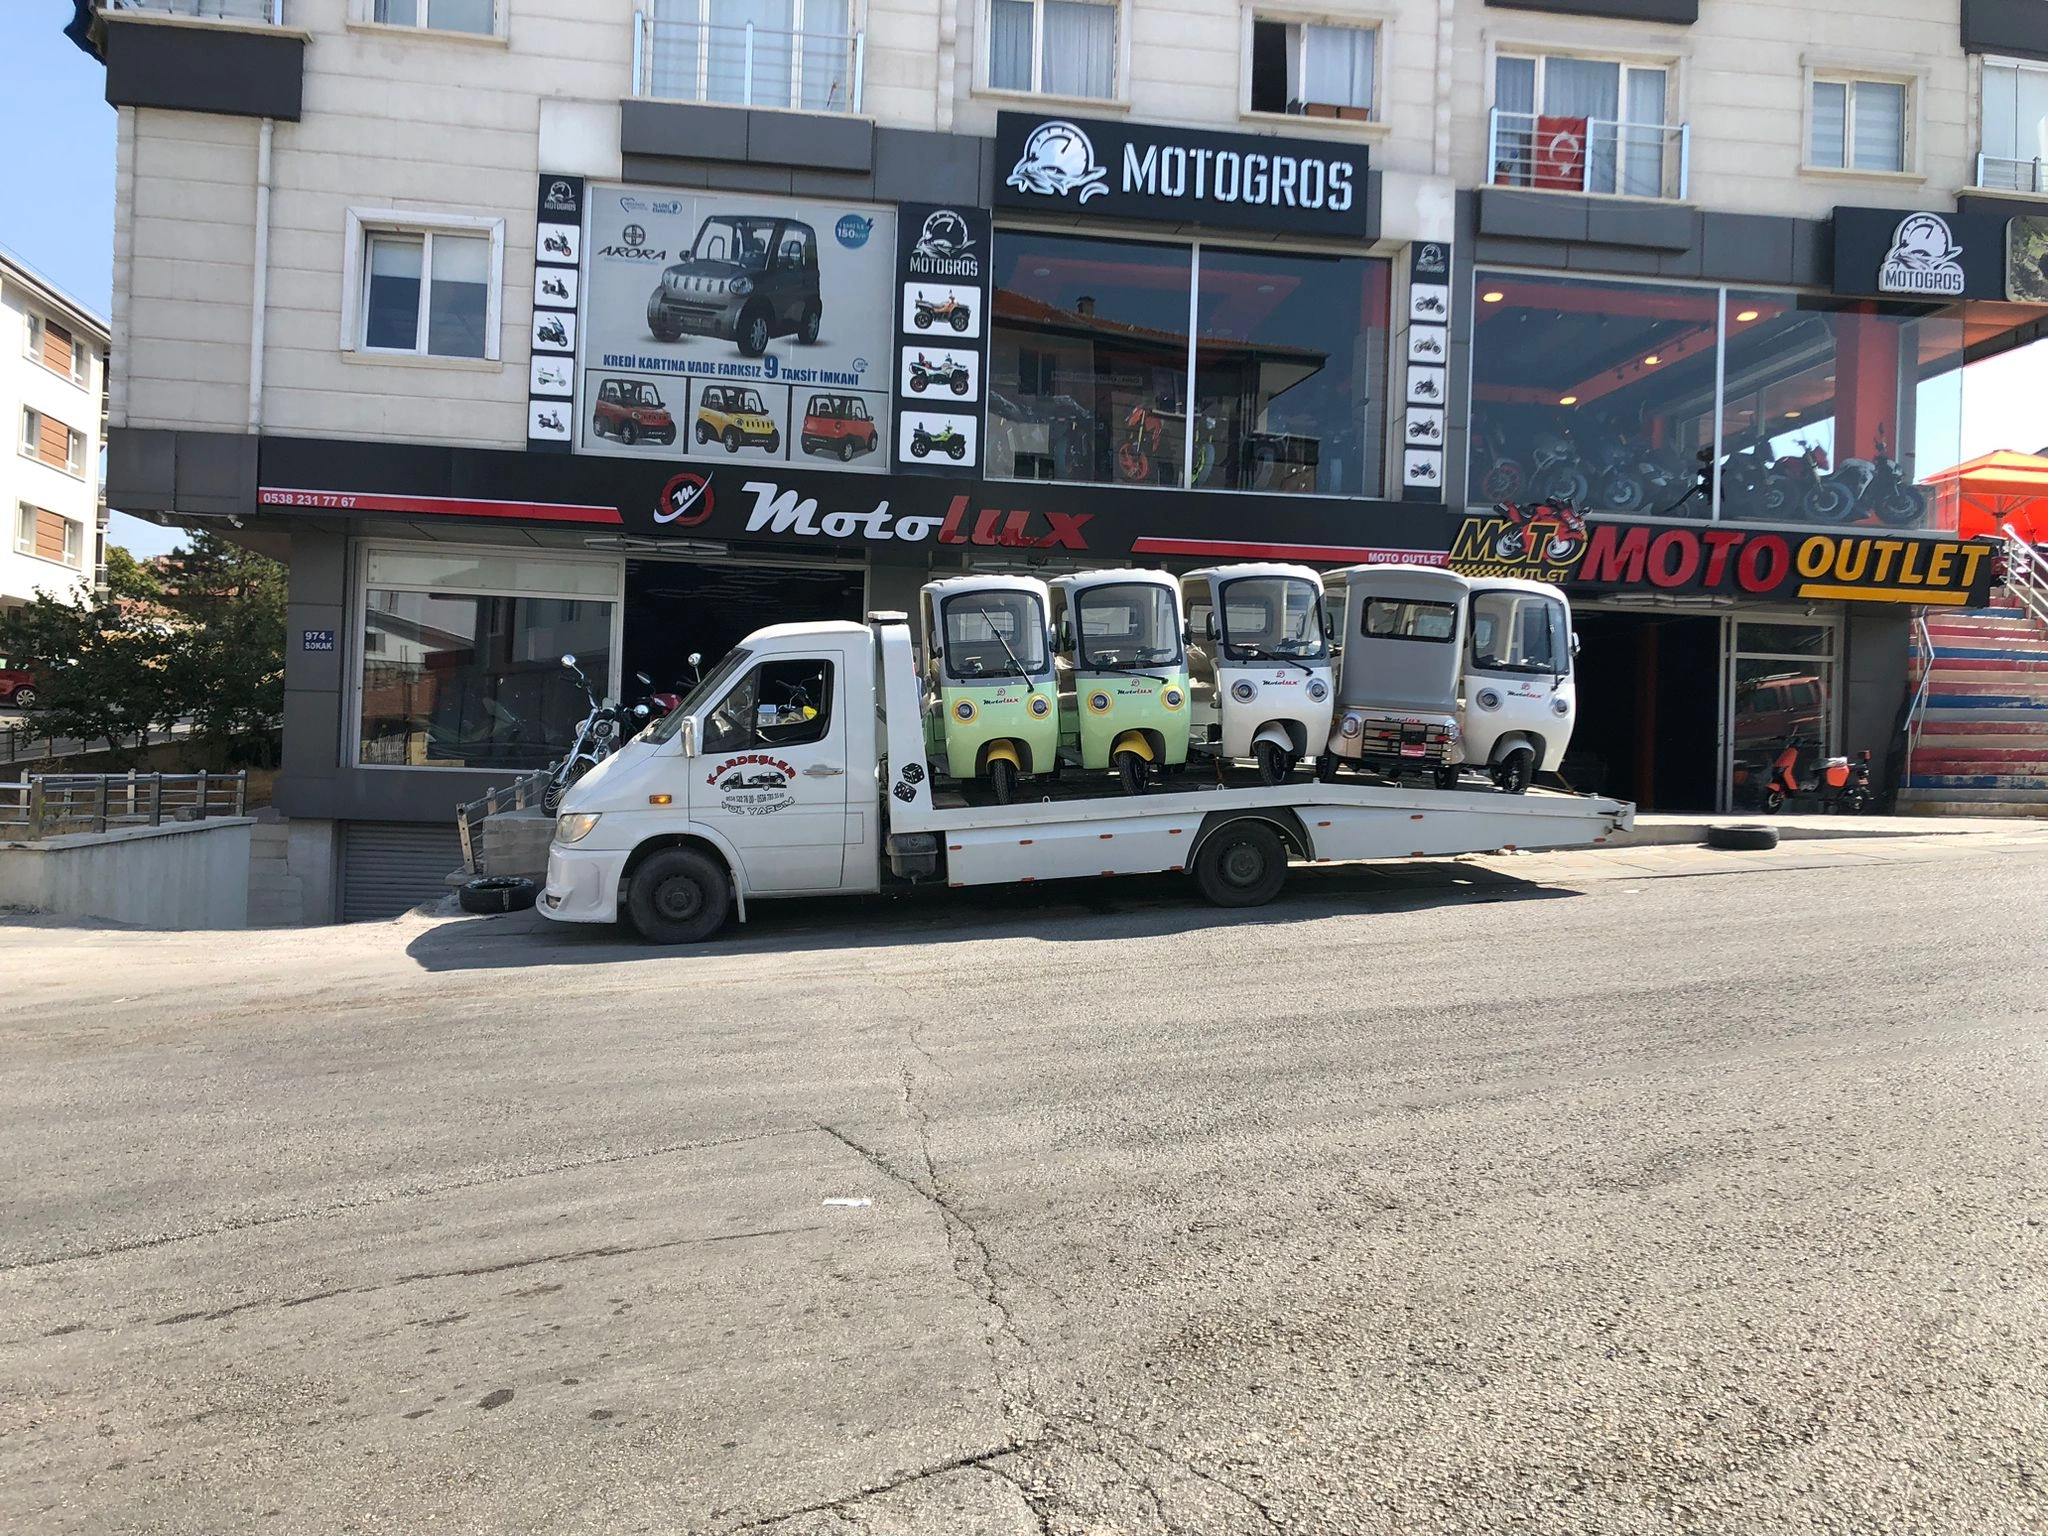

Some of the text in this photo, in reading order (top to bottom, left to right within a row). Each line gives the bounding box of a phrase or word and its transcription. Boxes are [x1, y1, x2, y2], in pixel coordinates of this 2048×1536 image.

[1121, 142, 1354, 211] MOTOGROS
[838, 229, 855, 239] 150
[598, 245, 667, 261] ARORA
[909, 256, 978, 277] MOTOGROS
[1885, 269, 1962, 291] MOTOGROS
[603, 354, 859, 386] KREDİ KARTINA VADE FARKSIZ 9 TAKSİT İMKANI
[262, 492, 357, 507] 0538 231 77 67
[1368, 552, 1444, 565] MOTO OUTLET
[1578, 526, 1993, 593] MOTO OUTLET
[1506, 567, 1568, 583] OUTLET
[304, 641, 332, 650] SOKAK
[721, 796, 796, 815] YOL YARDIM
